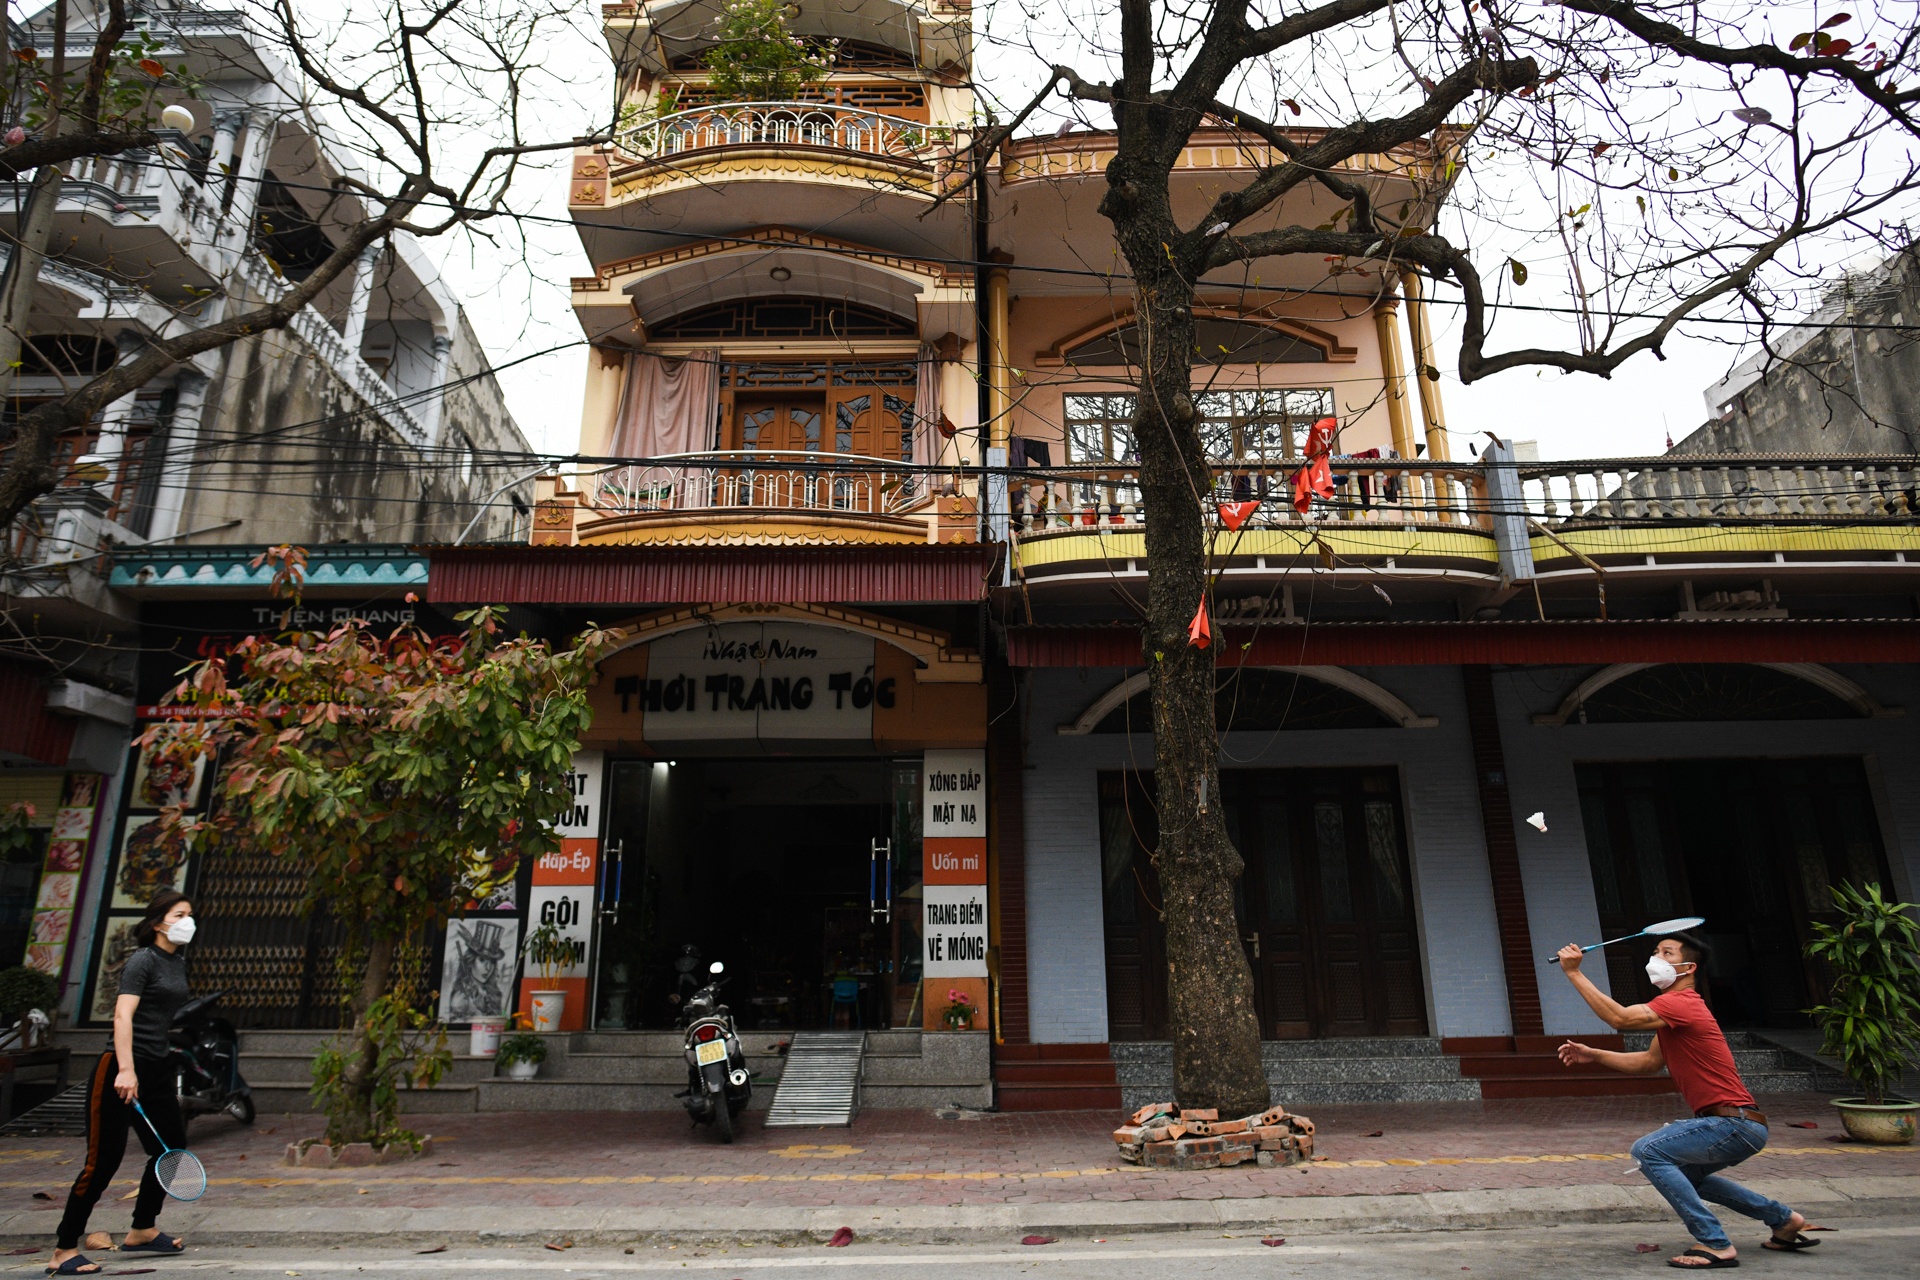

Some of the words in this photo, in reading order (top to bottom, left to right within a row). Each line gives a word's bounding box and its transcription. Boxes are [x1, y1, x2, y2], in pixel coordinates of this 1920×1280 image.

[332, 607, 415, 625] QUANG
[768, 639, 817, 660] Nam
[705, 673, 813, 711] TRANG
[829, 665, 895, 710] TÓC
[929, 770, 957, 791] XÔNG
[961, 768, 981, 791] ĐẮP
[933, 801, 955, 825] MẶT
[961, 804, 977, 825] NẠ
[932, 852, 959, 871] Uốn
[962, 854, 979, 870] mi
[540, 895, 579, 930] GỘI
[927, 904, 957, 925] TRANG
[960, 896, 983, 925] ĐIỂM
[928, 933, 942, 961] VẼ
[948, 931, 984, 961] MÓNG
